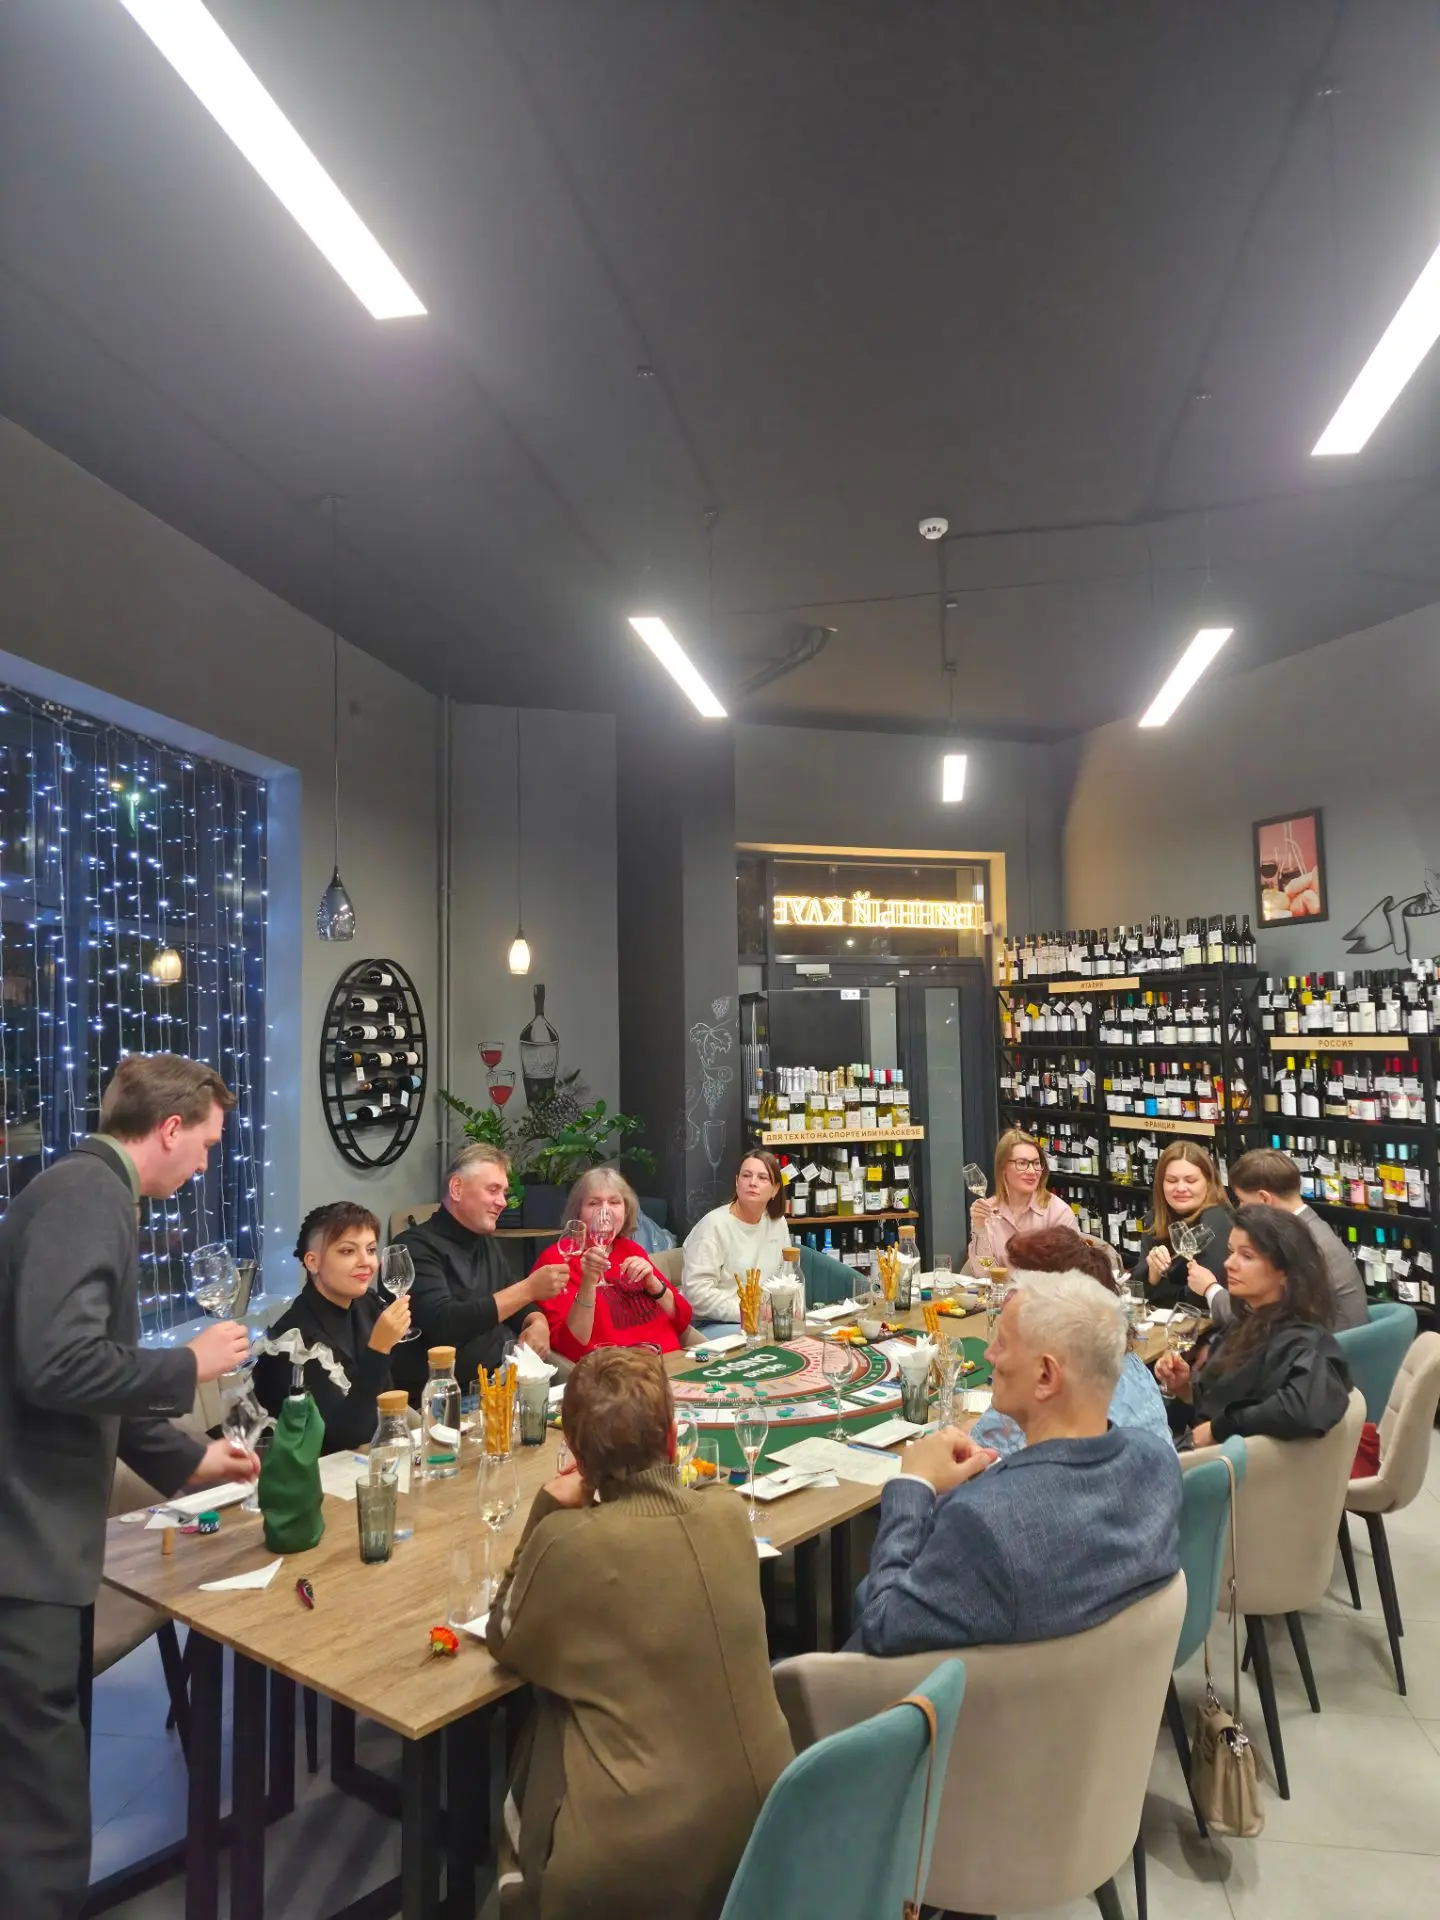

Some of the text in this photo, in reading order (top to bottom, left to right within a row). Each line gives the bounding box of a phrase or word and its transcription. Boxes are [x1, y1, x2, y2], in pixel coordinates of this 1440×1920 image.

[1318, 1039, 1353, 1048] РОССИЯ
[1144, 1120, 1176, 1130] ФРАНЦИЯ
[766, 1133, 782, 1141] ДЛЯ
[800, 1132, 816, 1140] КТО
[817, 1132, 828, 1140] НА
[829, 1131, 860, 1139] СПОРТЕ
[889, 1128, 921, 1136] АСКЕЗЕ
